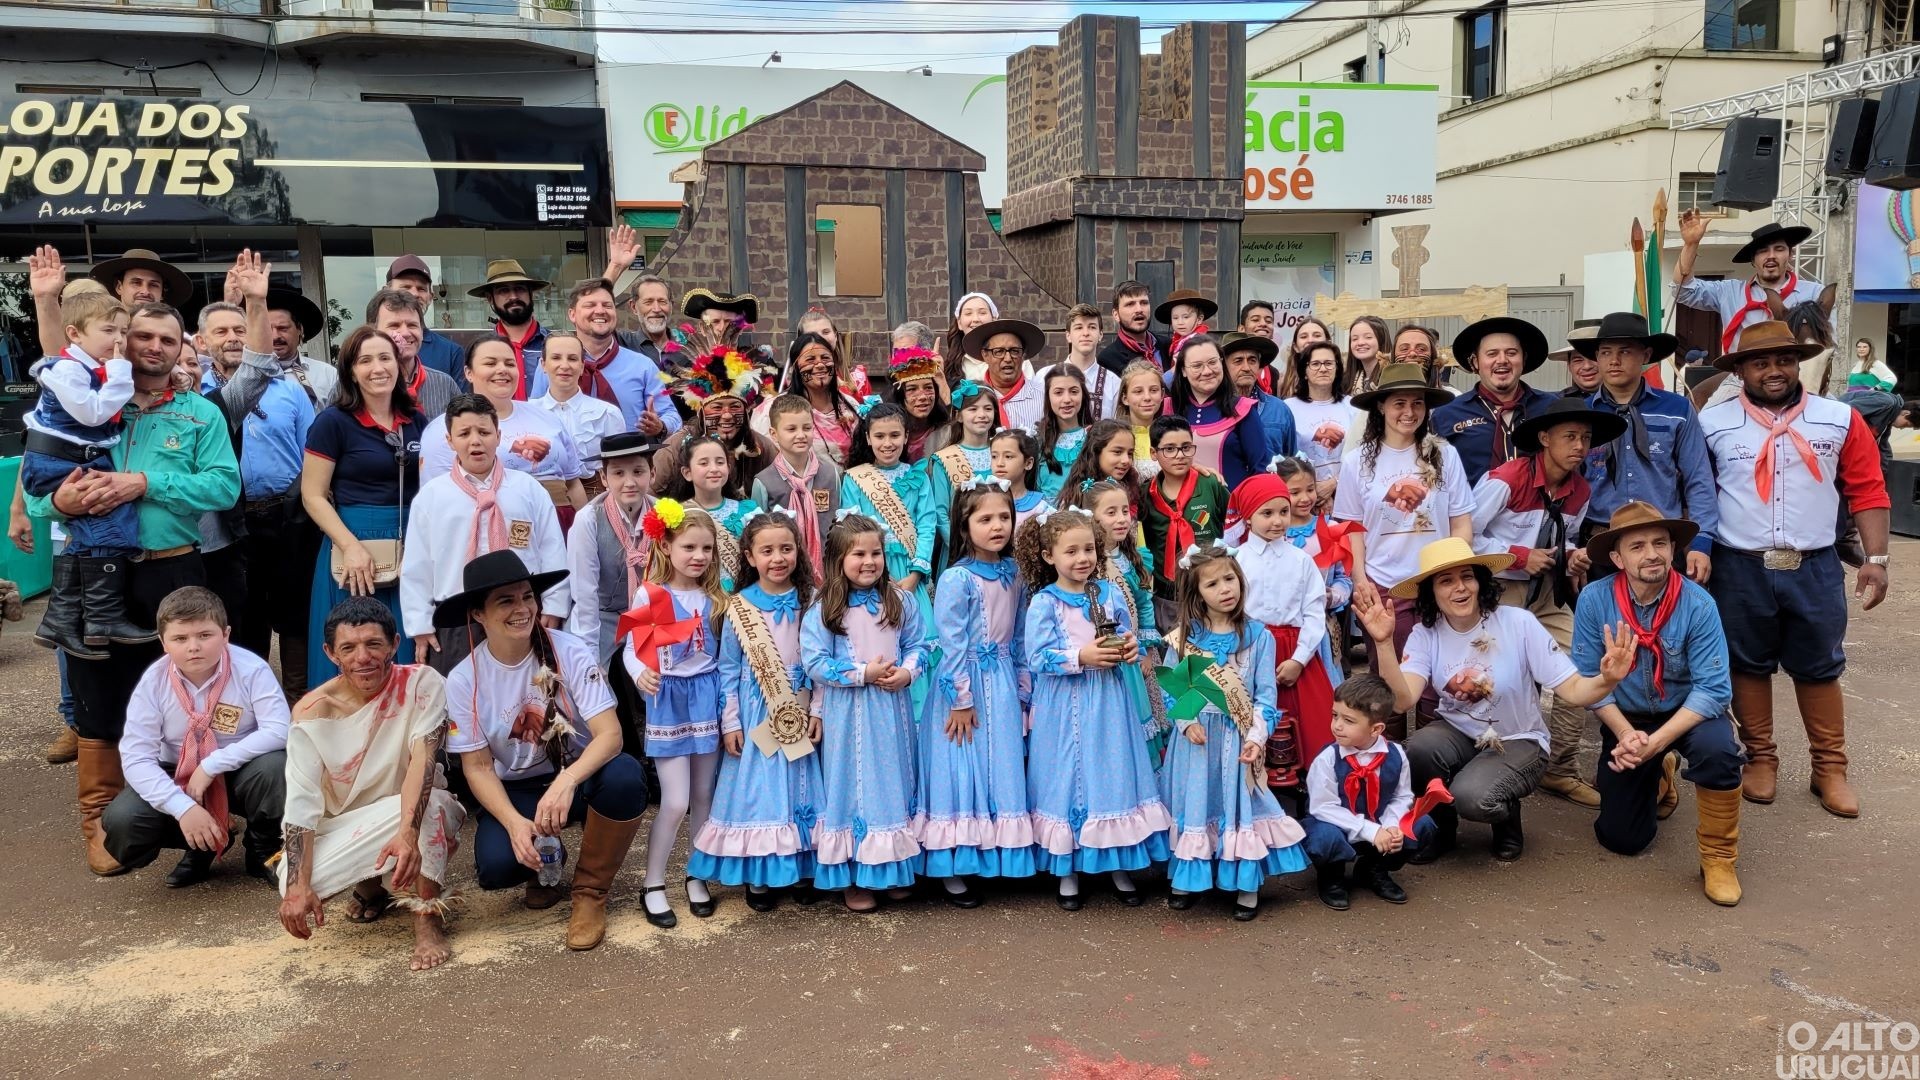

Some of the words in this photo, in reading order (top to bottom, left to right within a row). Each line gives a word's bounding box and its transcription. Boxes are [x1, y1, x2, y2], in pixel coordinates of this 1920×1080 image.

[0, 100, 119, 136] OJA
[137, 103, 250, 138] DOS
[0, 146, 240, 196] PORTES
[1244, 153, 1314, 201] osé
[38, 201, 53, 218] A
[57, 203, 97, 217] sua
[101, 198, 147, 217] loja
[1385, 194, 1408, 205] 3746
[1411, 194, 1433, 205] 1885
[1275, 240, 1285, 250] de
[1277, 310, 1312, 328] Jos
[730, 593, 758, 642] endinha
